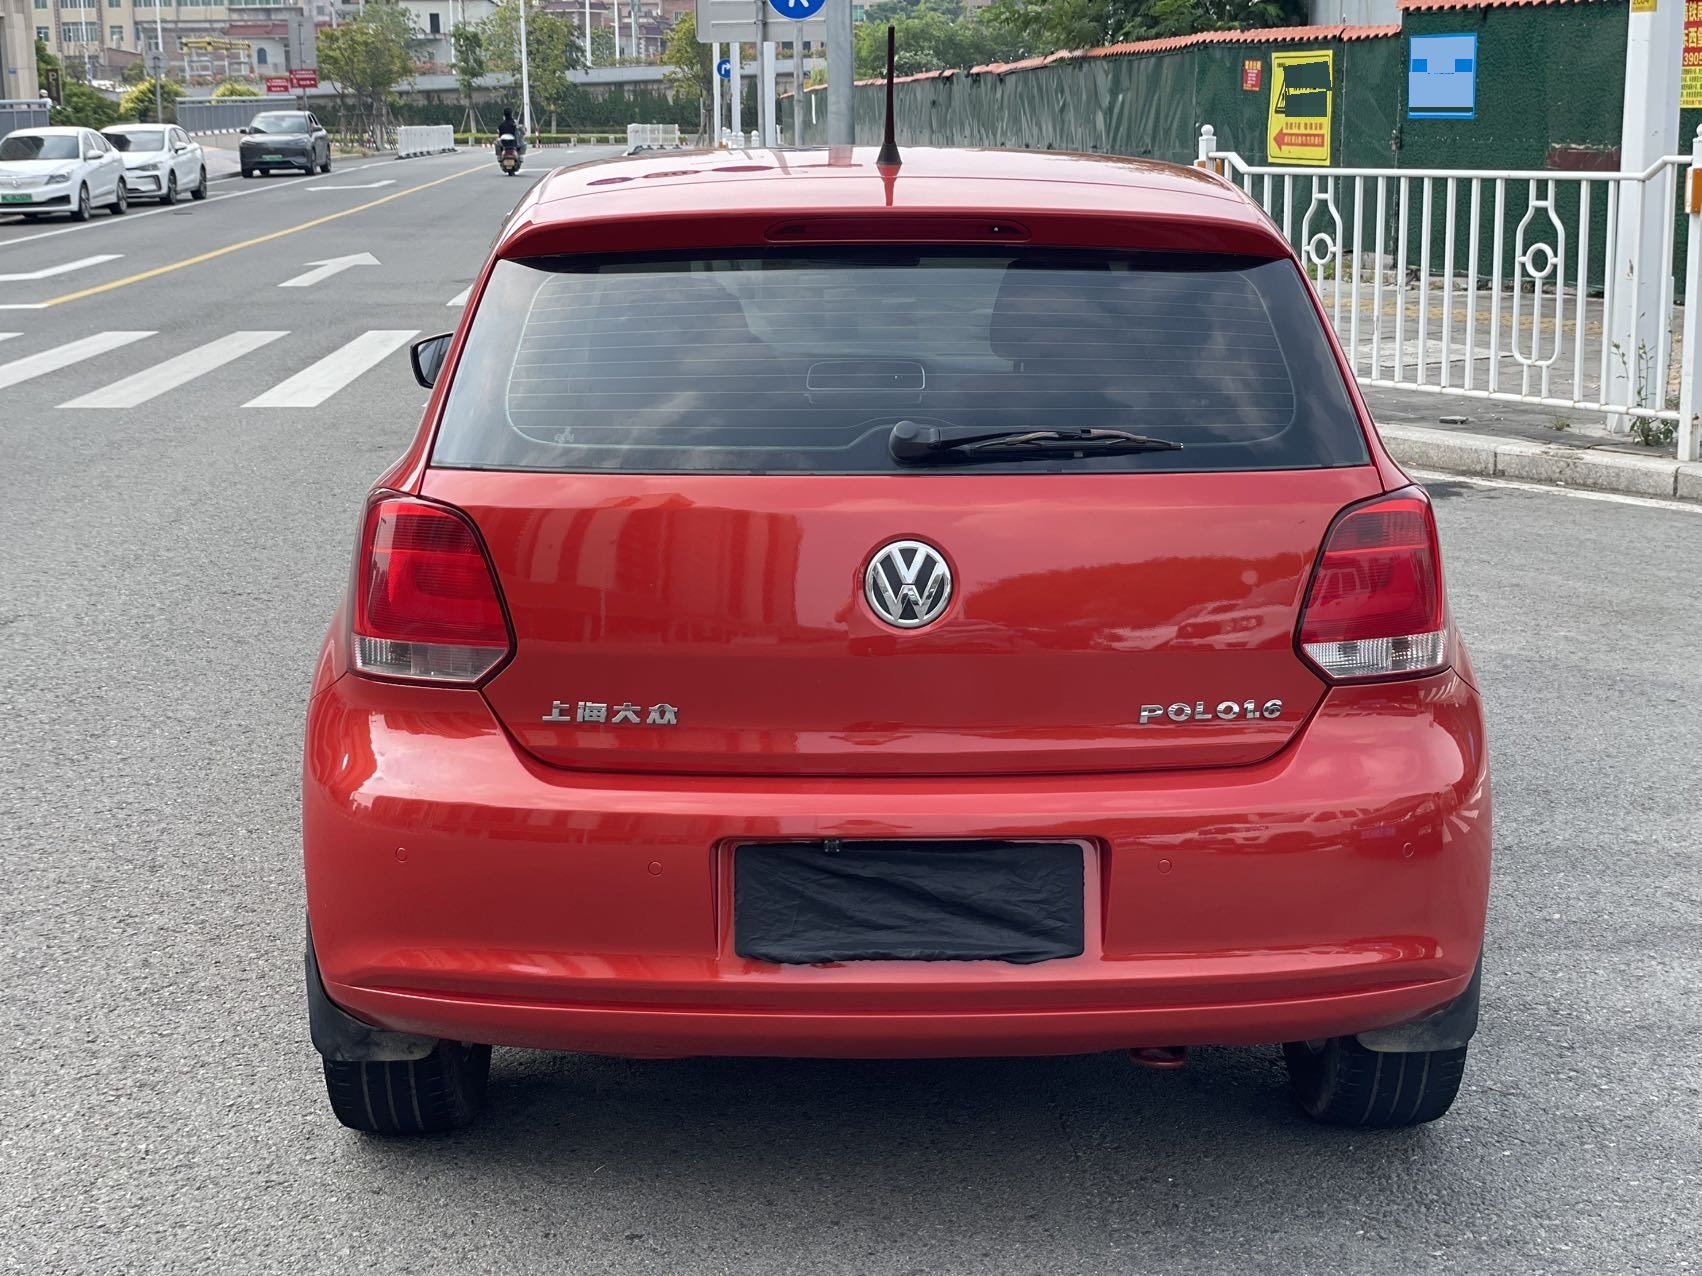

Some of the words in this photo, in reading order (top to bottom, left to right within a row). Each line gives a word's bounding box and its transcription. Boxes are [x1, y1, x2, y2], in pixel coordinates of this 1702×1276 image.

[865, 540, 952, 628] VW
[542, 700, 678, 725] 上海大众
